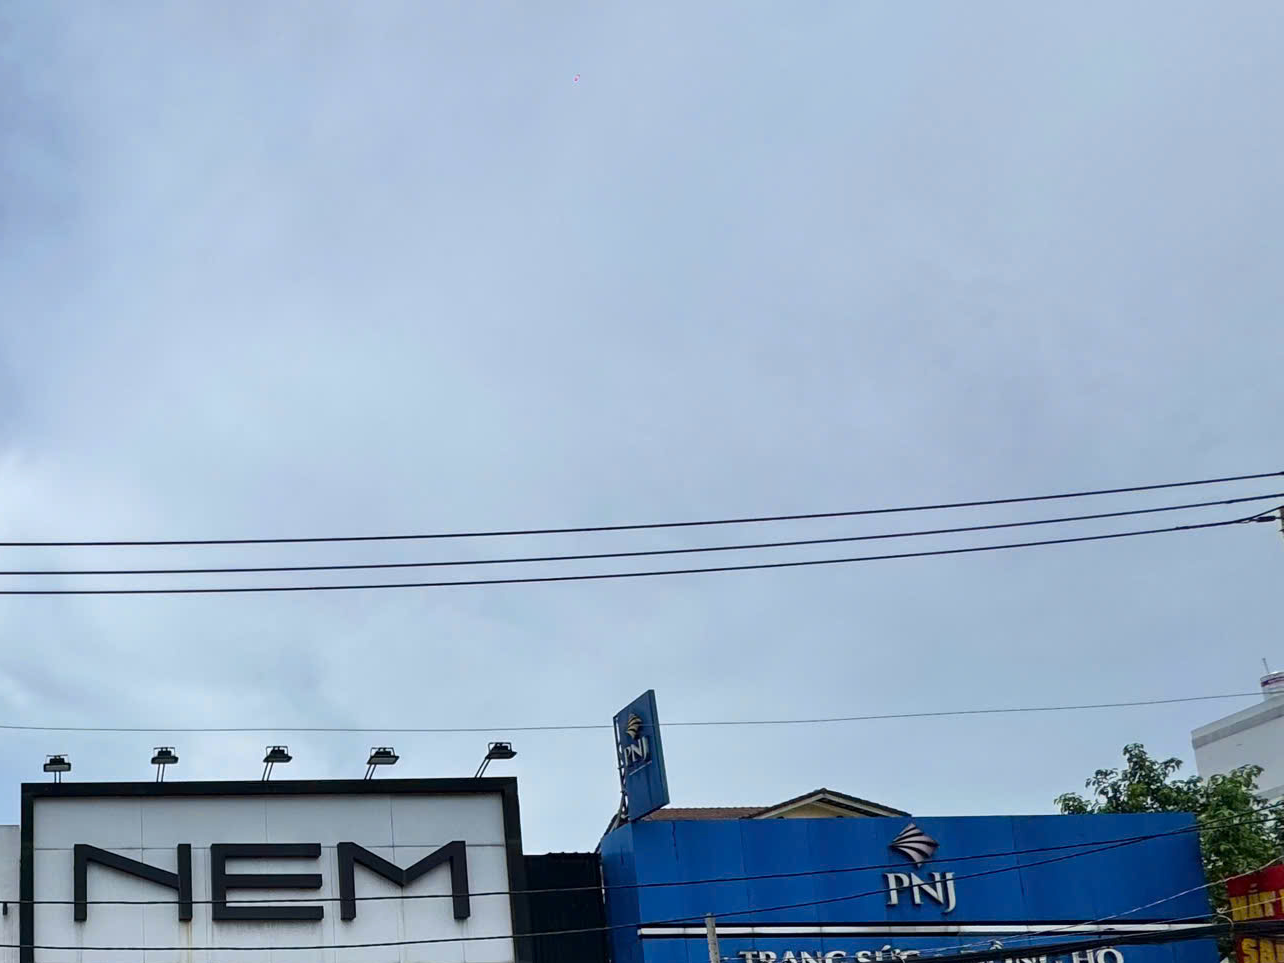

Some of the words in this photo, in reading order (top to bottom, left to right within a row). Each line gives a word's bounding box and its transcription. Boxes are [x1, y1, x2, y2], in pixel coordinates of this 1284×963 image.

[624, 736, 650, 766] PNJ
[74, 840, 470, 921] NEM
[884, 871, 957, 913] PNJ
